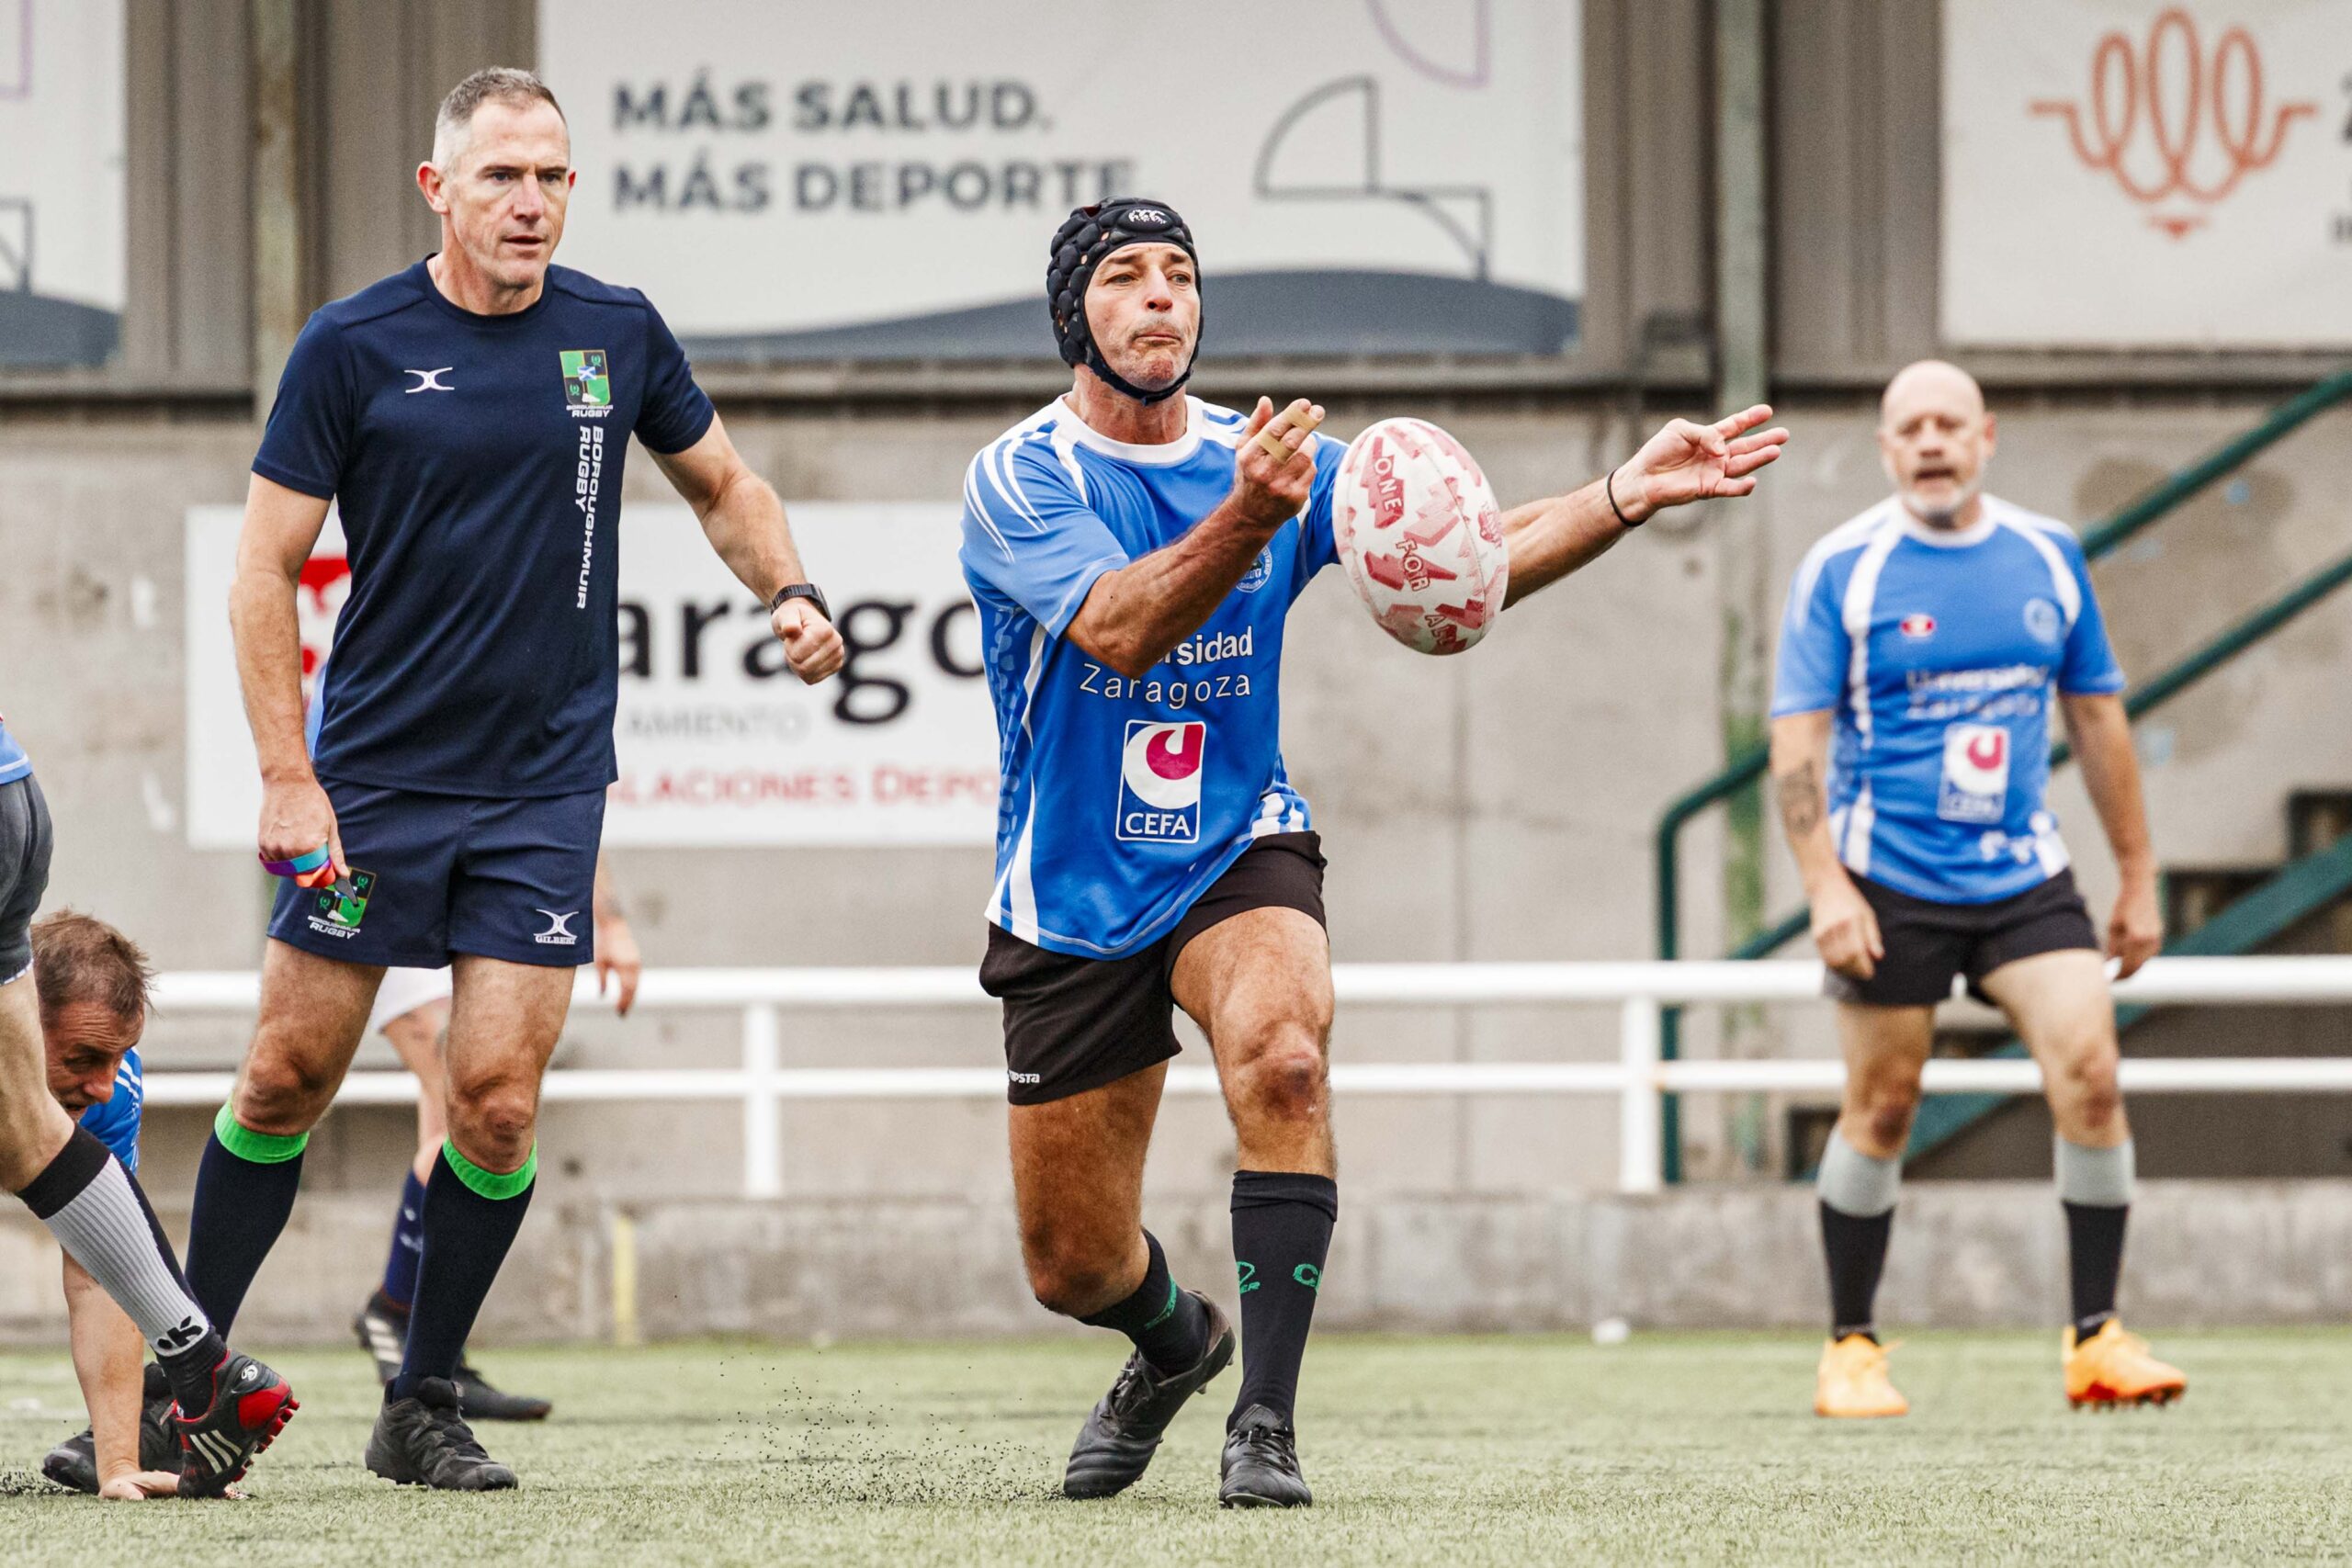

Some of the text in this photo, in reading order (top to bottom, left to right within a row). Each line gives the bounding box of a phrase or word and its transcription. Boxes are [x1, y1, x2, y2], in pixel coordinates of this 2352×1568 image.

[614, 66, 770, 132] MÁS
[614, 147, 1135, 212] MÁS DEPORTE
[571, 410, 610, 418] RUGBY
[575, 425, 592, 513] RUGBY
[1374, 457, 1403, 512] ONE
[576, 425, 605, 610] BOROUGHMUIR
[1396, 539, 1430, 592] FOR
[1158, 626, 1254, 666] rsidad
[1080, 662, 1250, 710] Zaragoza
[1125, 812, 1192, 837] CEFA
[310, 921, 355, 939] RUGBY
